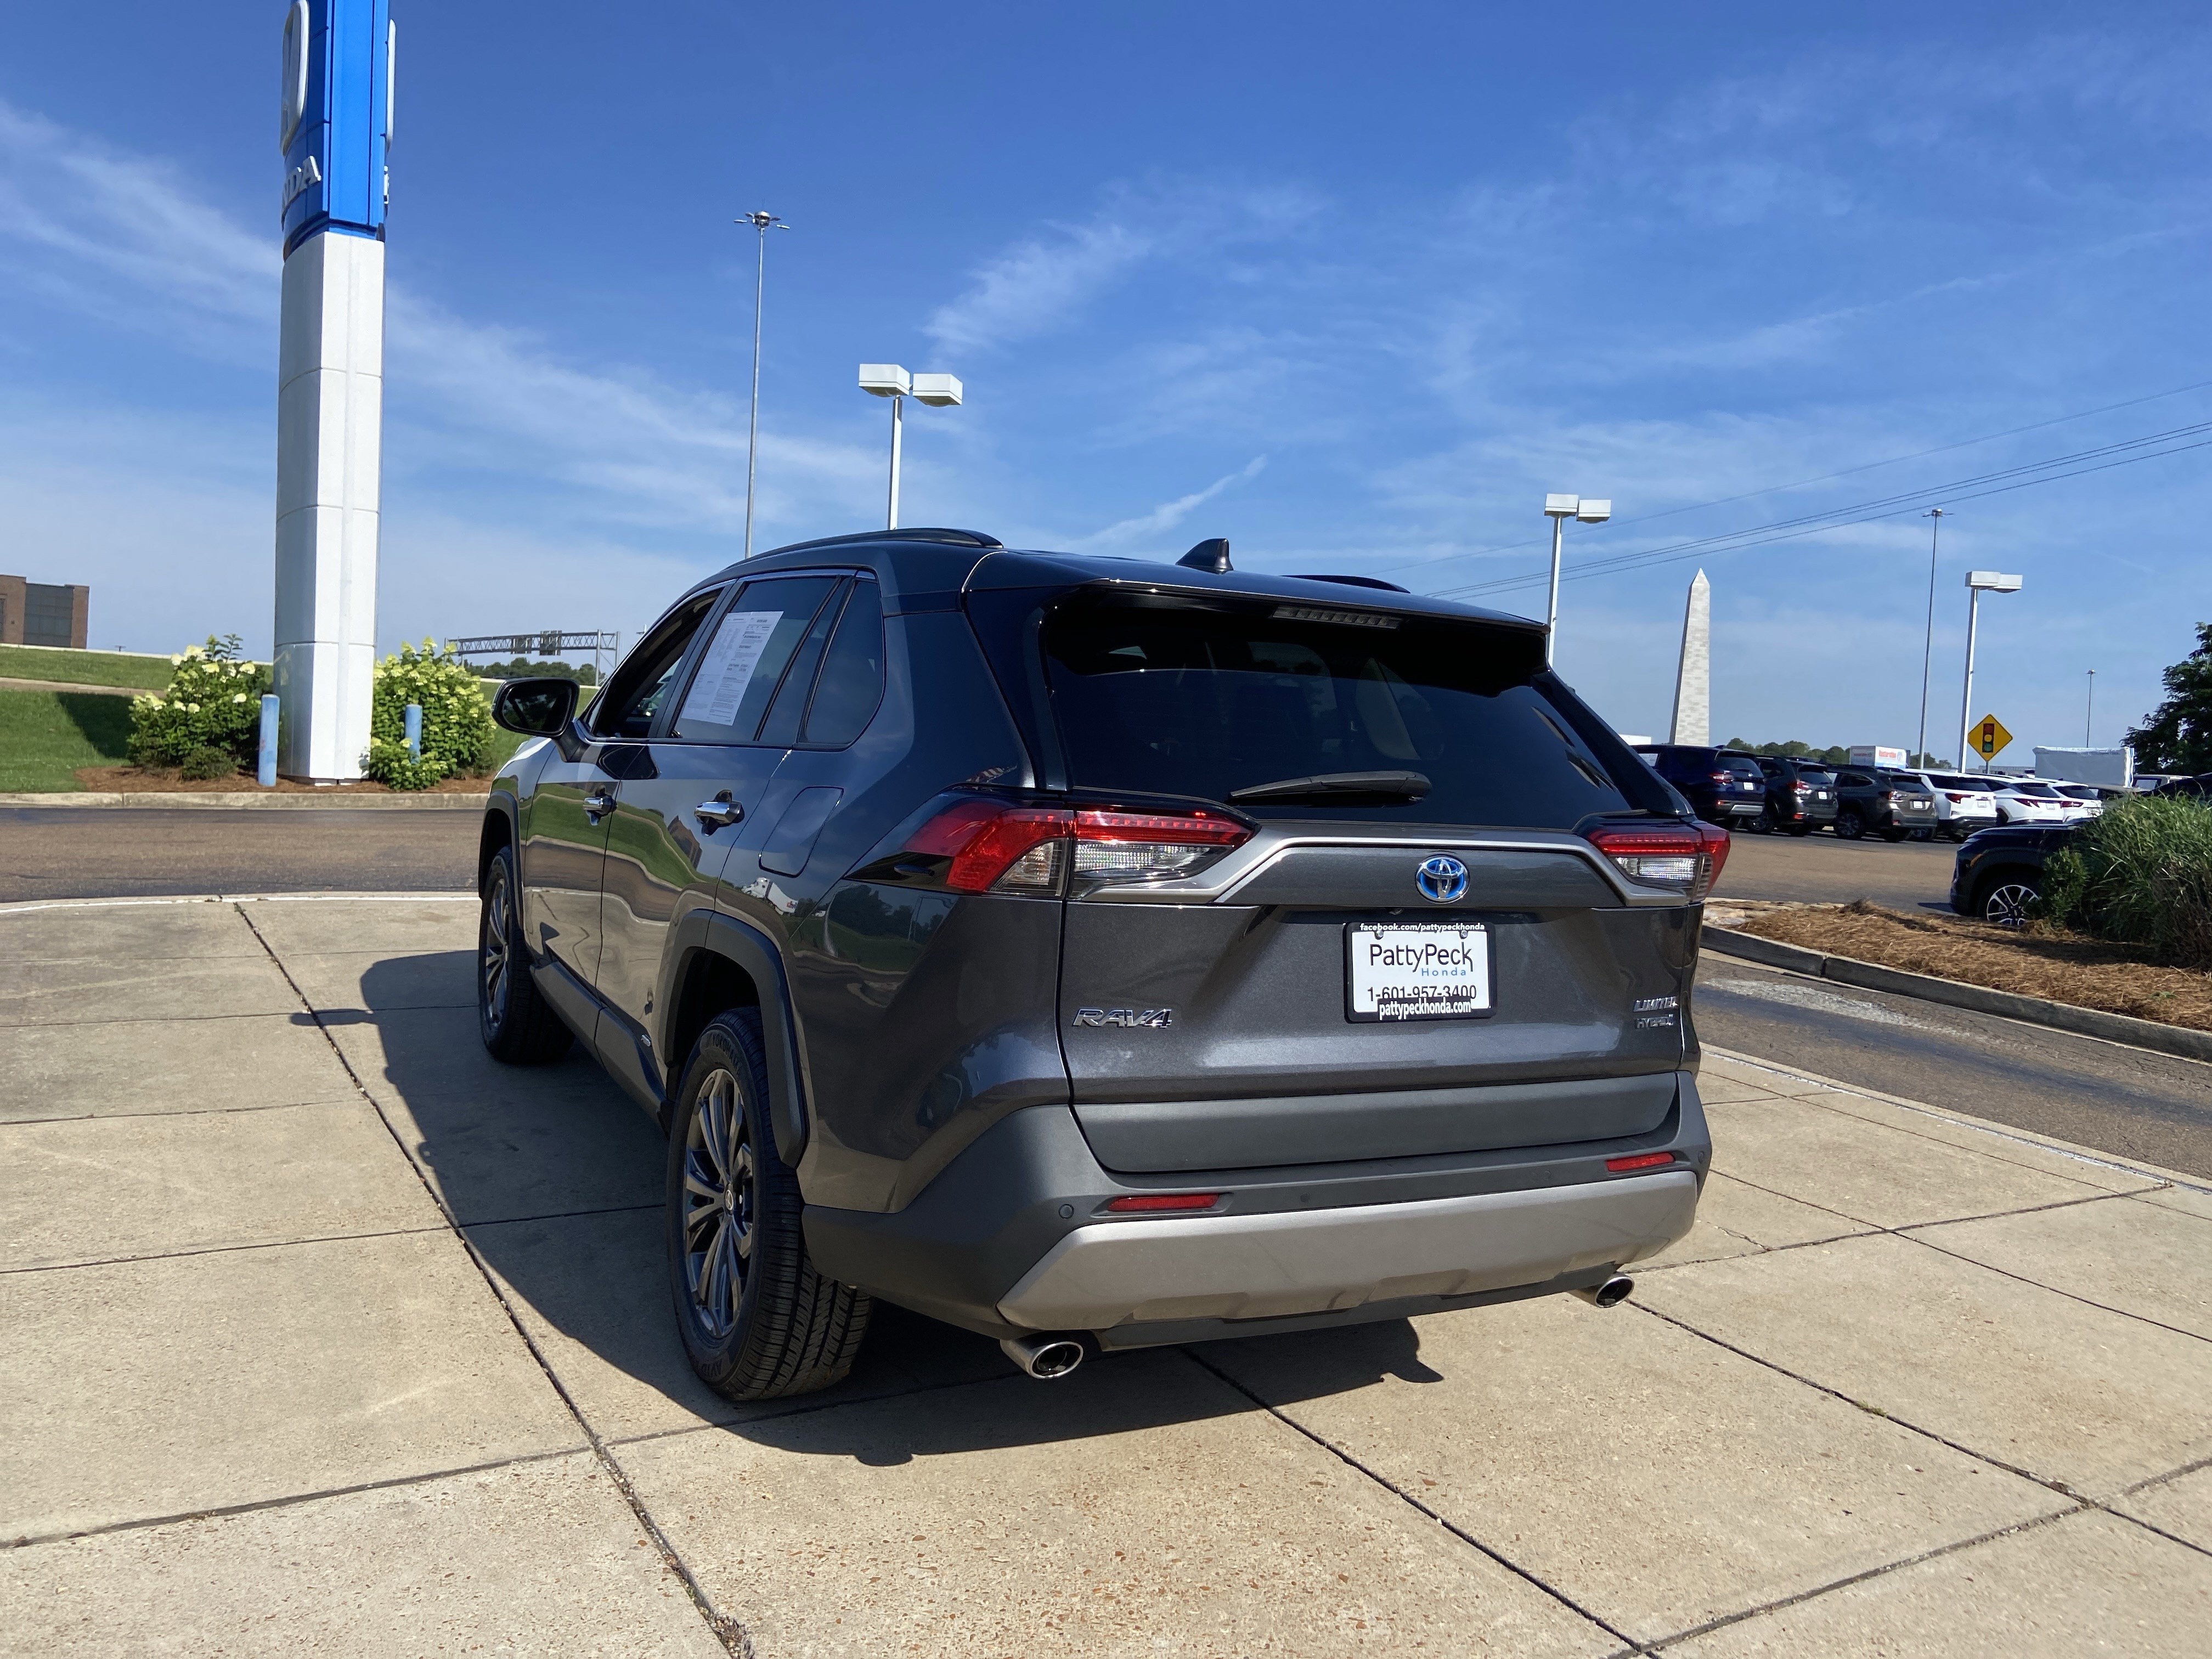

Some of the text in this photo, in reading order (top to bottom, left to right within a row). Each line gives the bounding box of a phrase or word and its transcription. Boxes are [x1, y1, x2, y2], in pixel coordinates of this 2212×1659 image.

[1359, 923, 1485, 932] facebook.com/pattypeckhonda
[1369, 942, 1473, 972] PattyPeck
[1421, 967, 1466, 977] Honda
[1367, 985, 1477, 1002] 1-601-957-3400
[1073, 1007, 1172, 1028] RAV4
[1379, 997, 1471, 1020] pattypeckhonda.com
